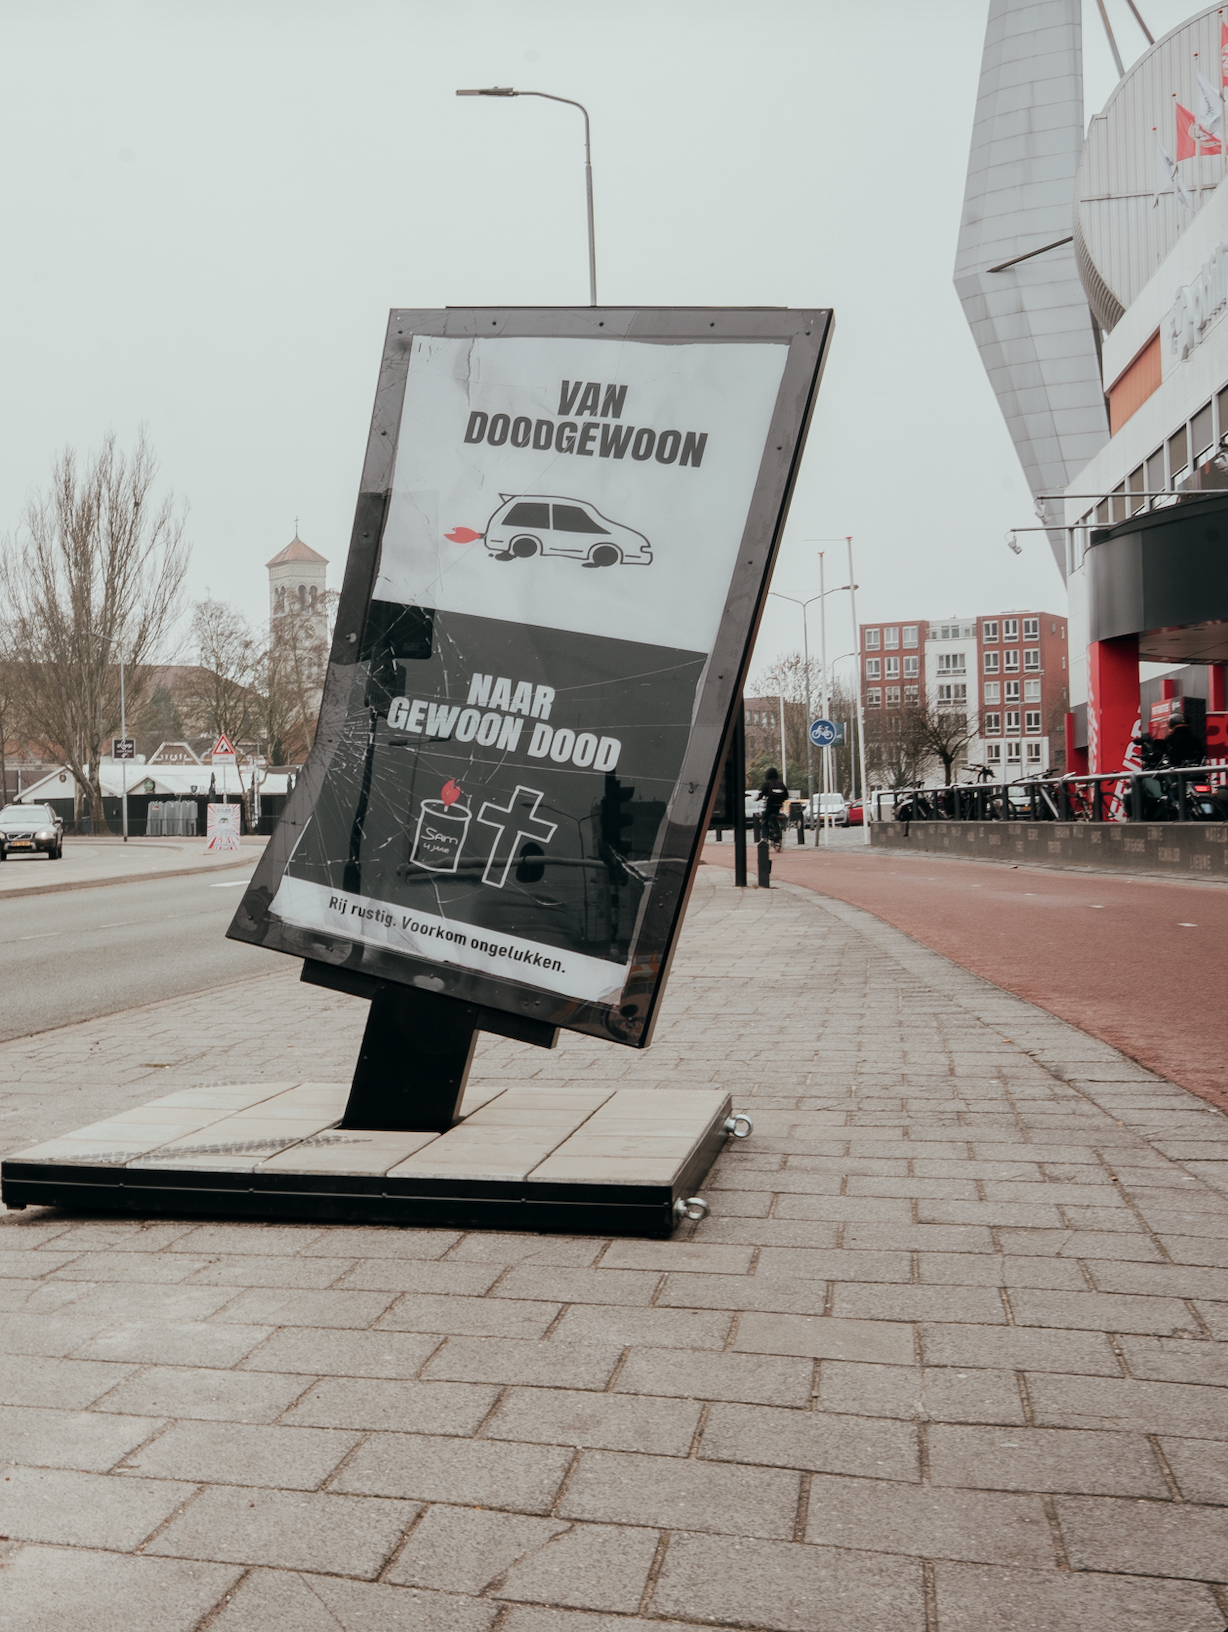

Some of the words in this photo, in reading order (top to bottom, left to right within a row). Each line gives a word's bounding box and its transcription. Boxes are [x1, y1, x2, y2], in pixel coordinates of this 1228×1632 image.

[557, 380, 628, 419] VAN
[463, 411, 709, 468] DOODGEWOON
[466, 672, 556, 721] NAAR
[386, 696, 525, 752] GEWOON
[527, 722, 622, 773] DOOD
[423, 842, 431, 850] 4
[328, 895, 348, 915] Rij
[350, 903, 397, 928] rustig.
[401, 915, 468, 947] Voorkom
[470, 938, 567, 974] ongelukken.
